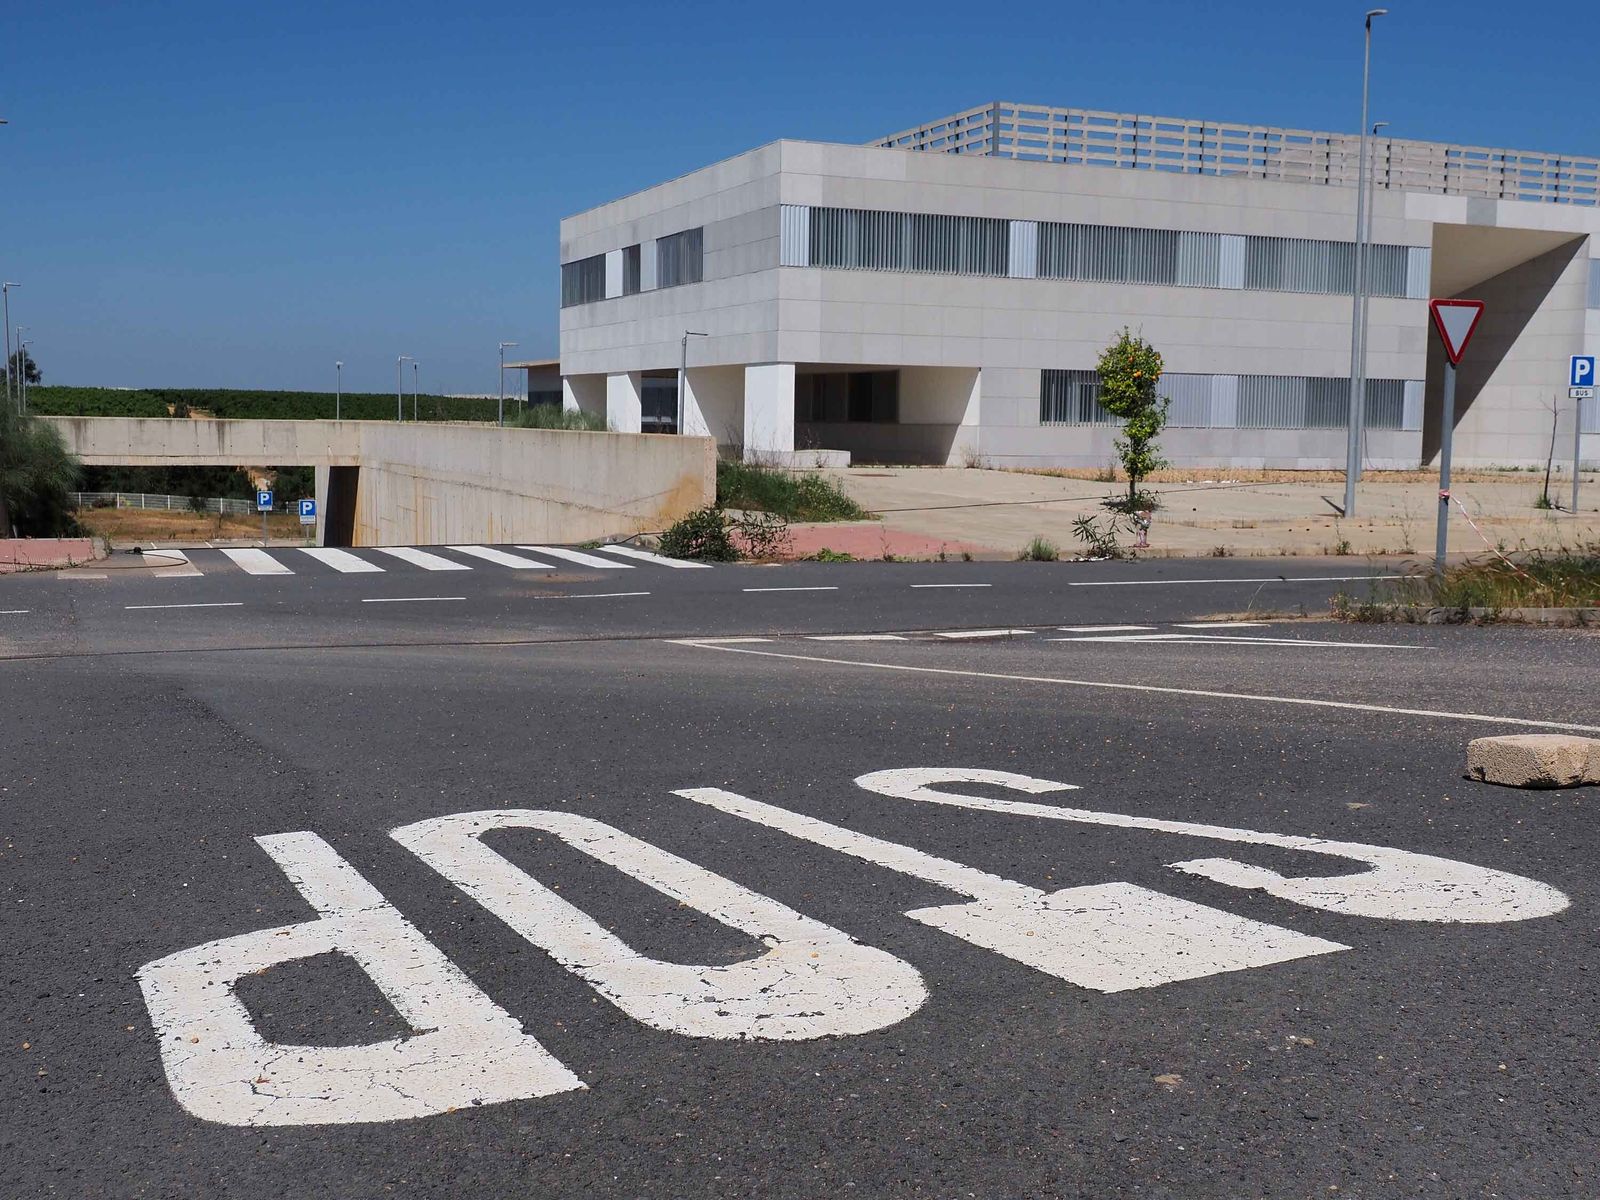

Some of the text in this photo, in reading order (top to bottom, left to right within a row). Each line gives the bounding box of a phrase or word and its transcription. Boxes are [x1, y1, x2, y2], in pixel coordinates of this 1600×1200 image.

[1575, 359, 1591, 384] P
[1575, 389, 1589, 397] BUS
[260, 493, 270, 505] P
[302, 501, 313, 515] P
[135, 767, 1570, 1127] STOP
